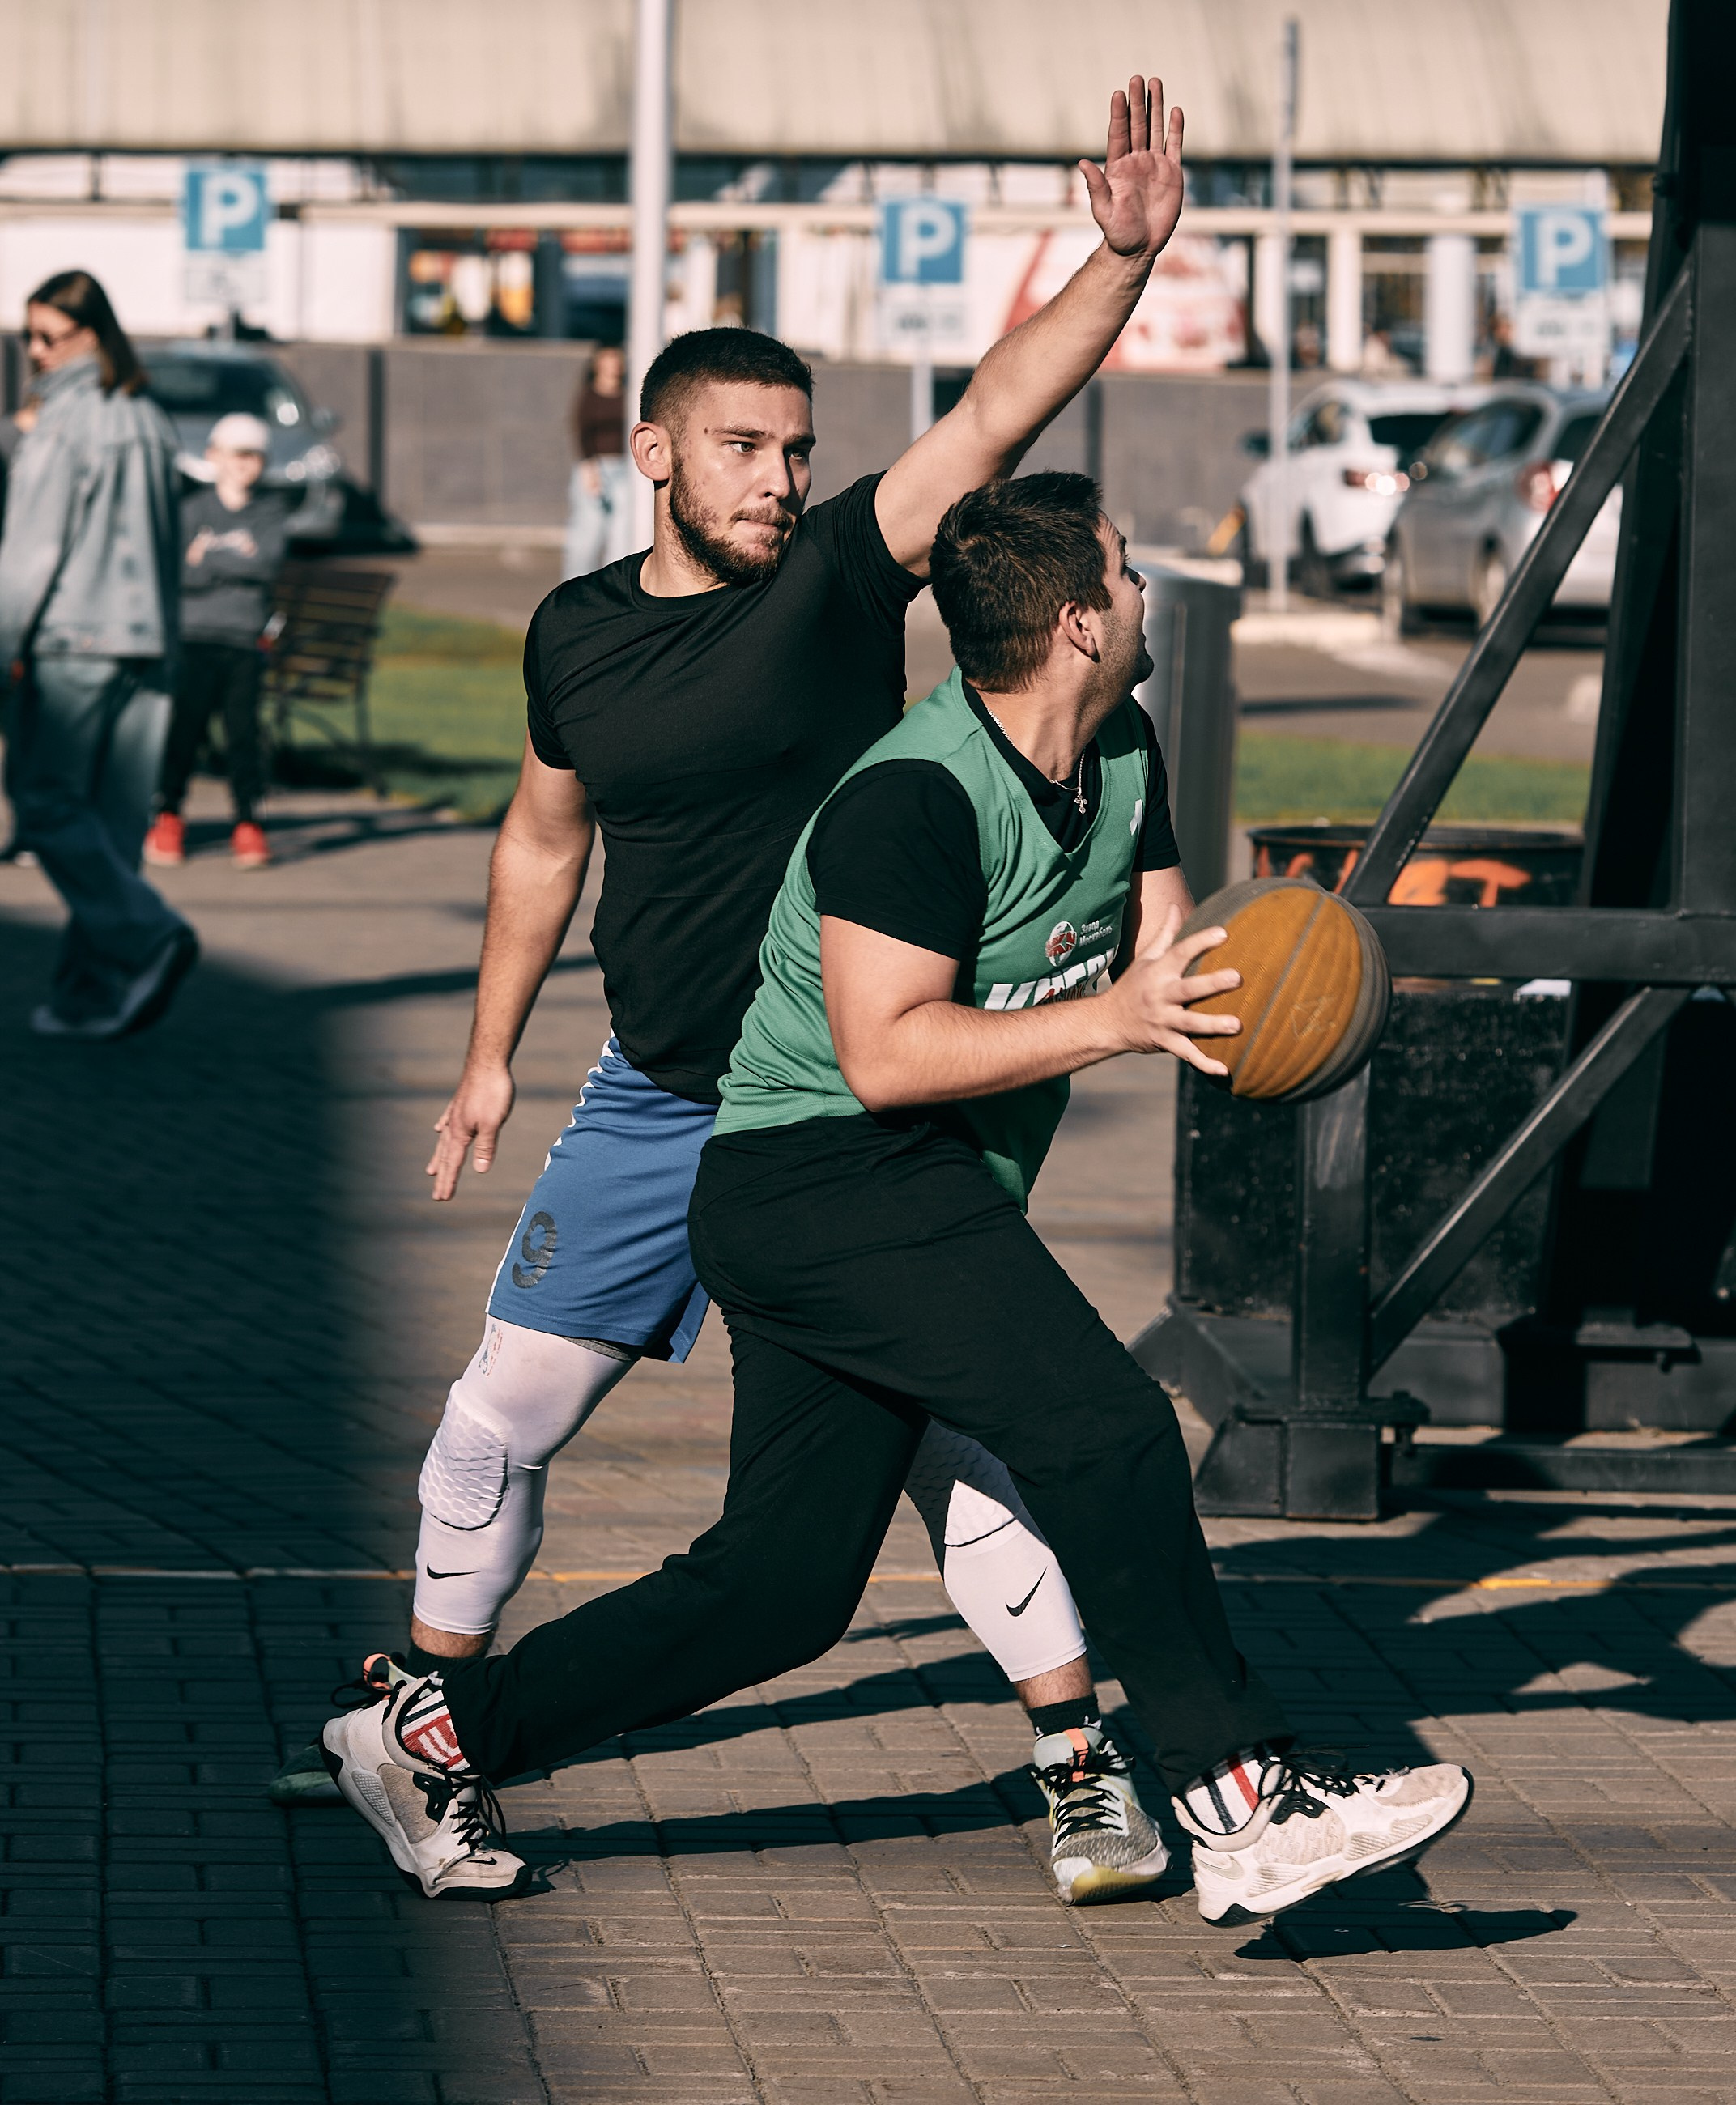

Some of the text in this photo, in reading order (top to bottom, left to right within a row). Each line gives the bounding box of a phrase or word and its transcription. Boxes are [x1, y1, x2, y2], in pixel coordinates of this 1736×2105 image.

[202, 172, 259, 245] P
[899, 203, 955, 278] P
[1538, 215, 1593, 287] P
[512, 1210, 557, 1289] 9
